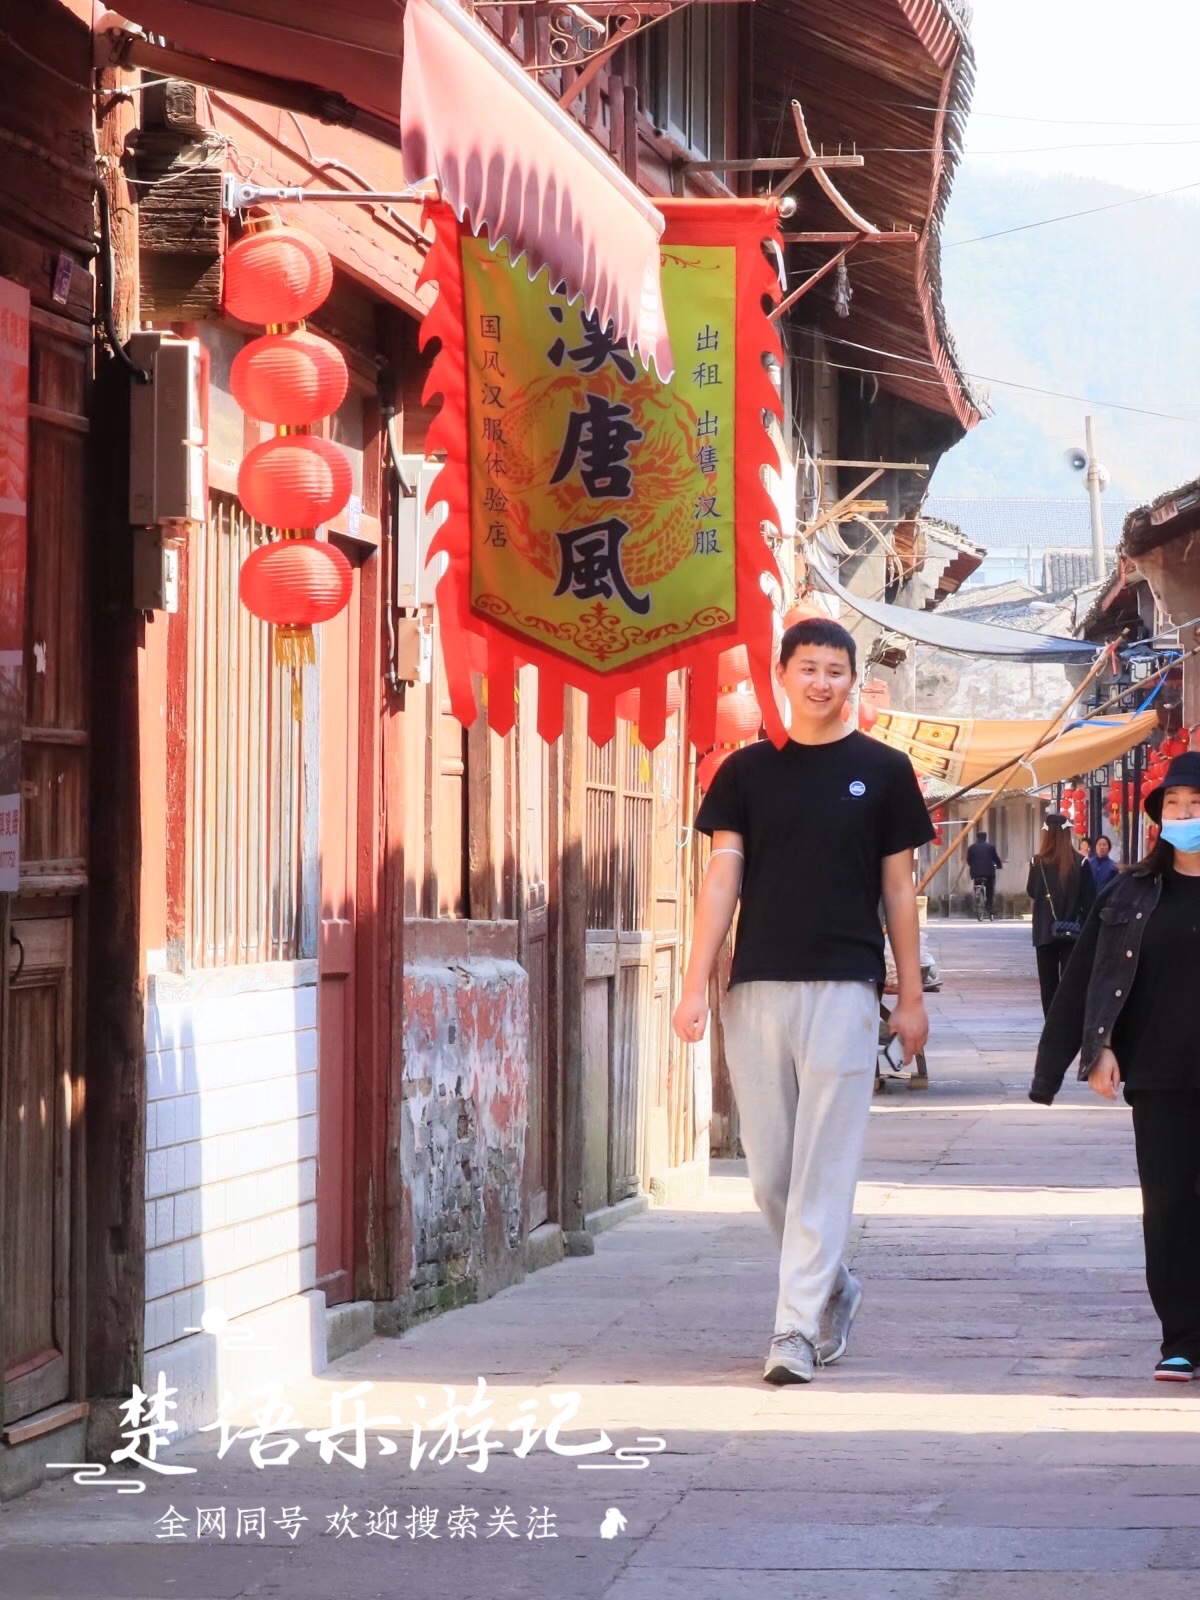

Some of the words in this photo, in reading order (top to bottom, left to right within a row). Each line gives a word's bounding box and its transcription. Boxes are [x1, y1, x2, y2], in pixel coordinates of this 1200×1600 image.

[480, 314, 509, 548] 国风汉服体验店
[546, 281, 651, 614] 漢唐風
